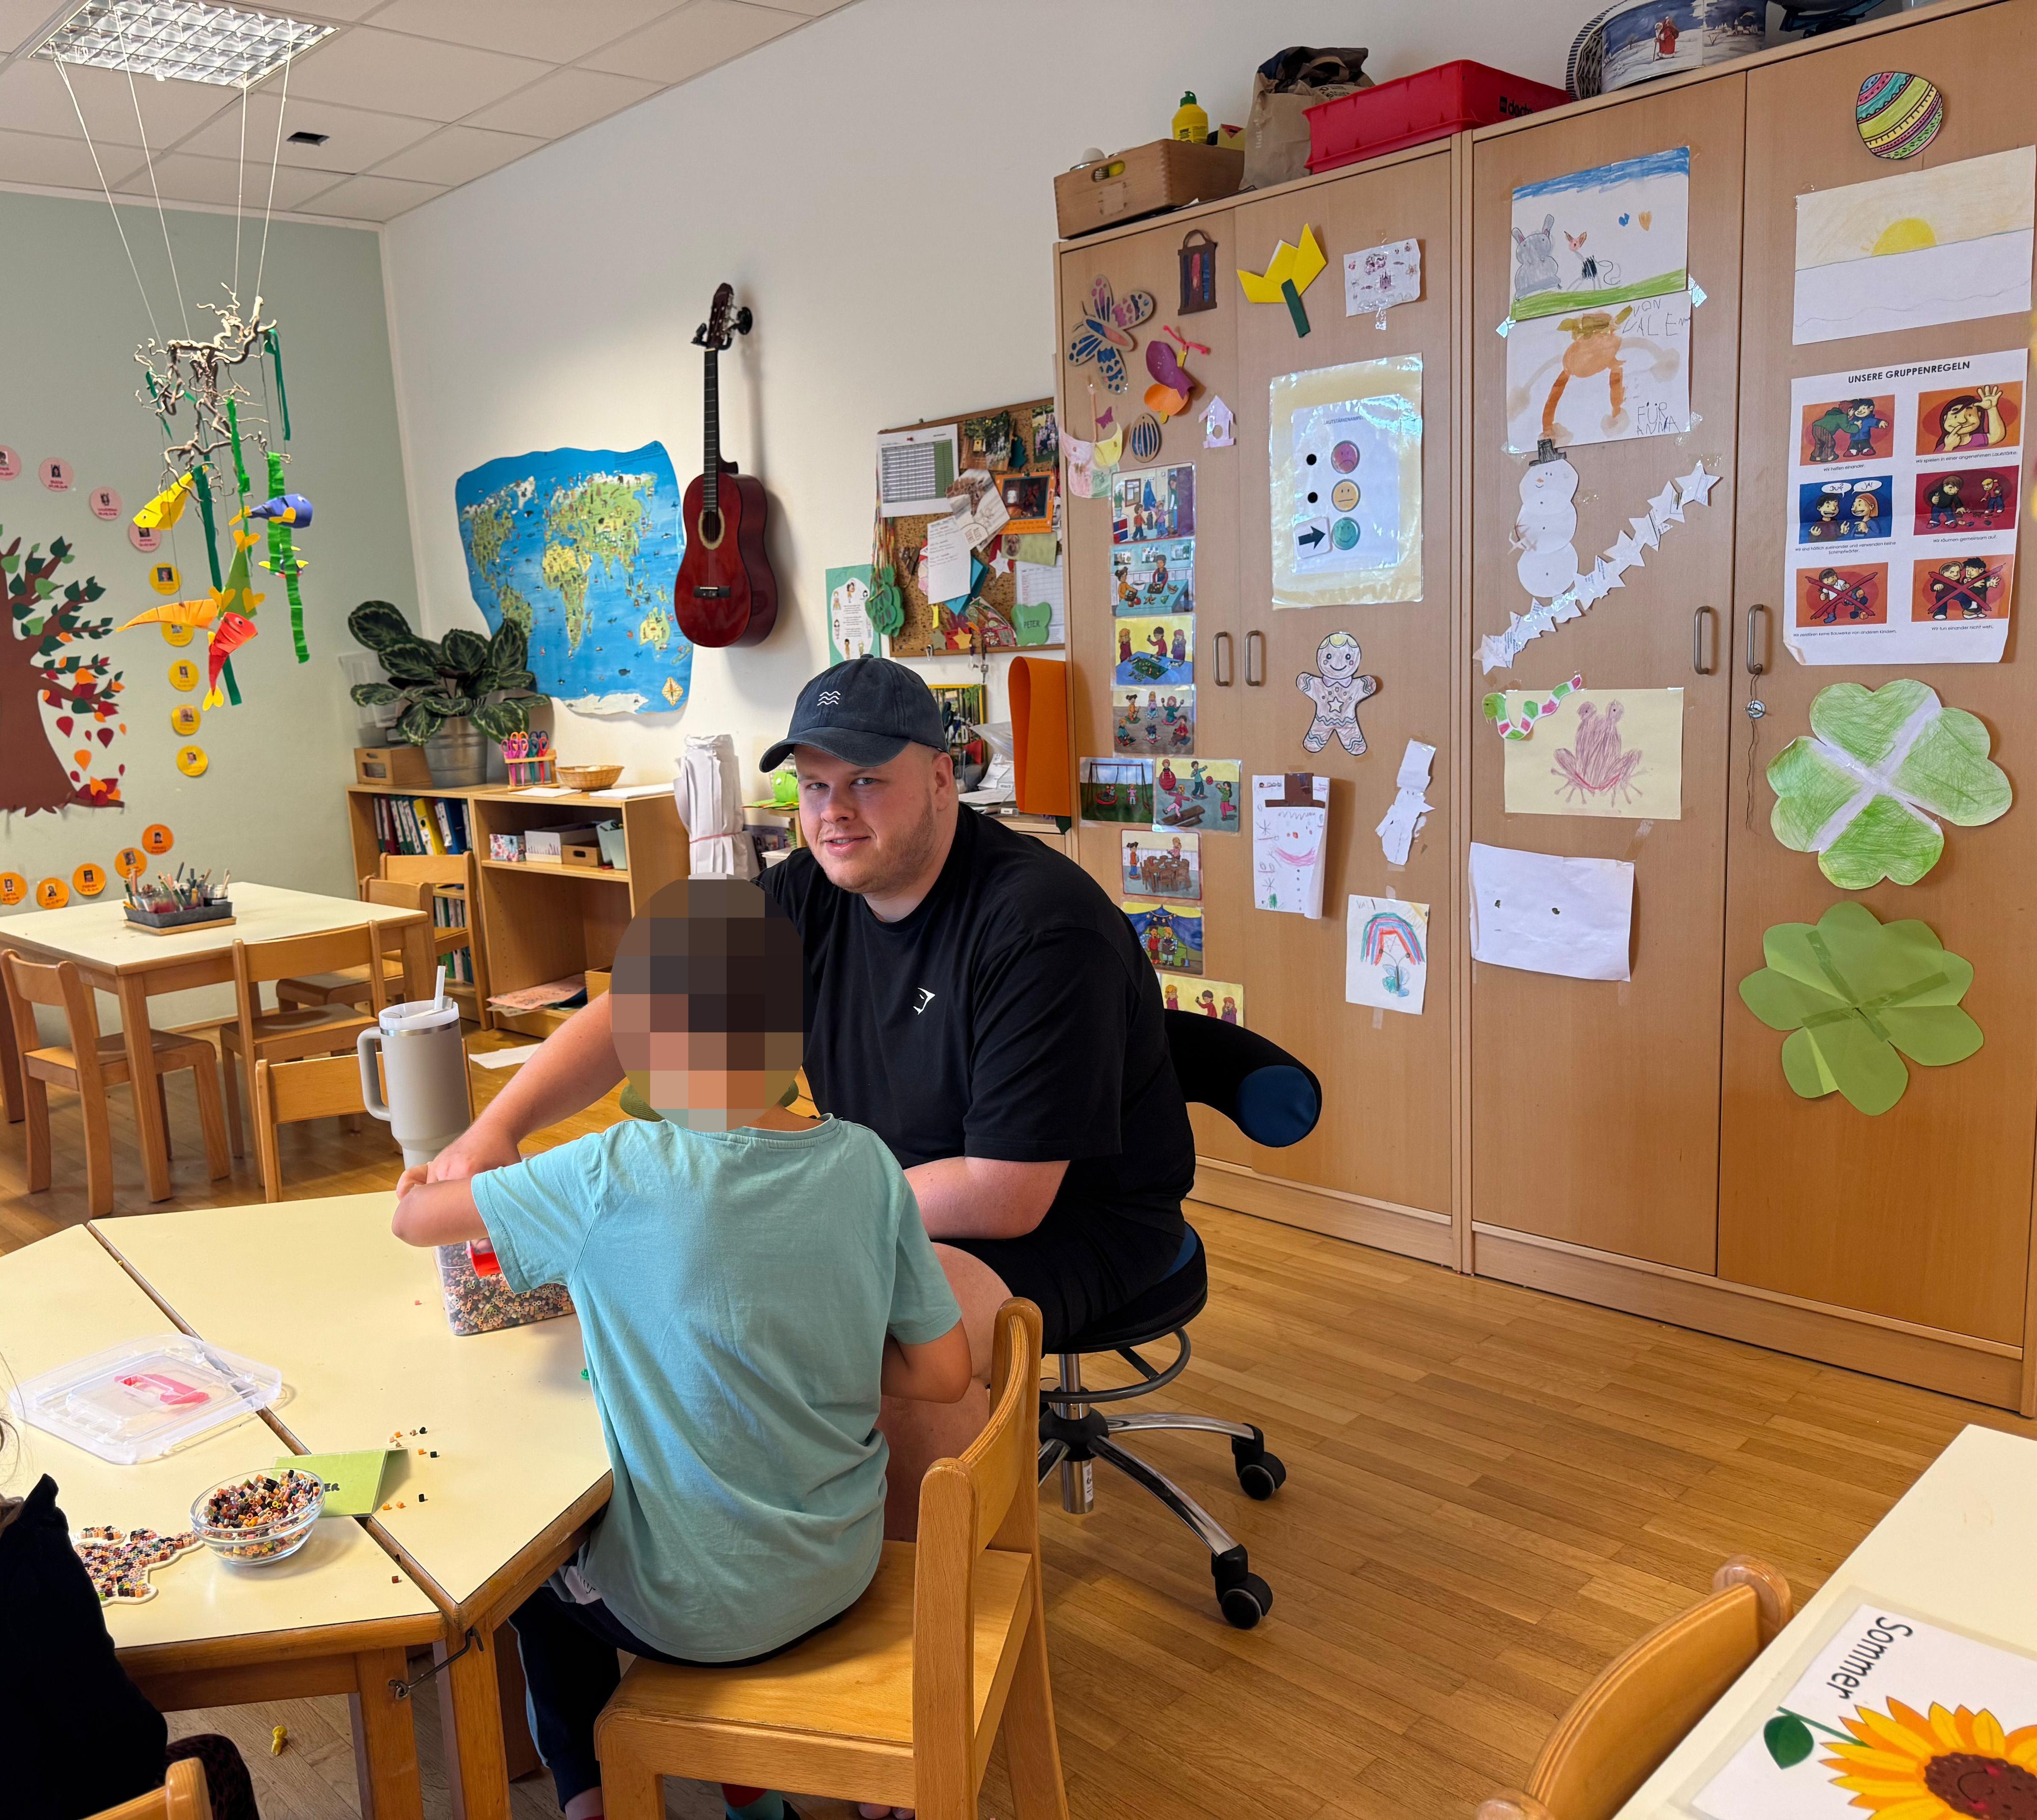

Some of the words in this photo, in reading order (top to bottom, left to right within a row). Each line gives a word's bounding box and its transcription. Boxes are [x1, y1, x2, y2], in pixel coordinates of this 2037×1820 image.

[1633, 298, 1661, 317] VON
[1848, 372, 1883, 383] UNSERE
[1885, 361, 1970, 378] GRUPPENREGELN
[1638, 401, 1668, 424] FÜR
[1024, 620, 1040, 628] PETER
[1826, 1616, 1913, 1700] Sommer
